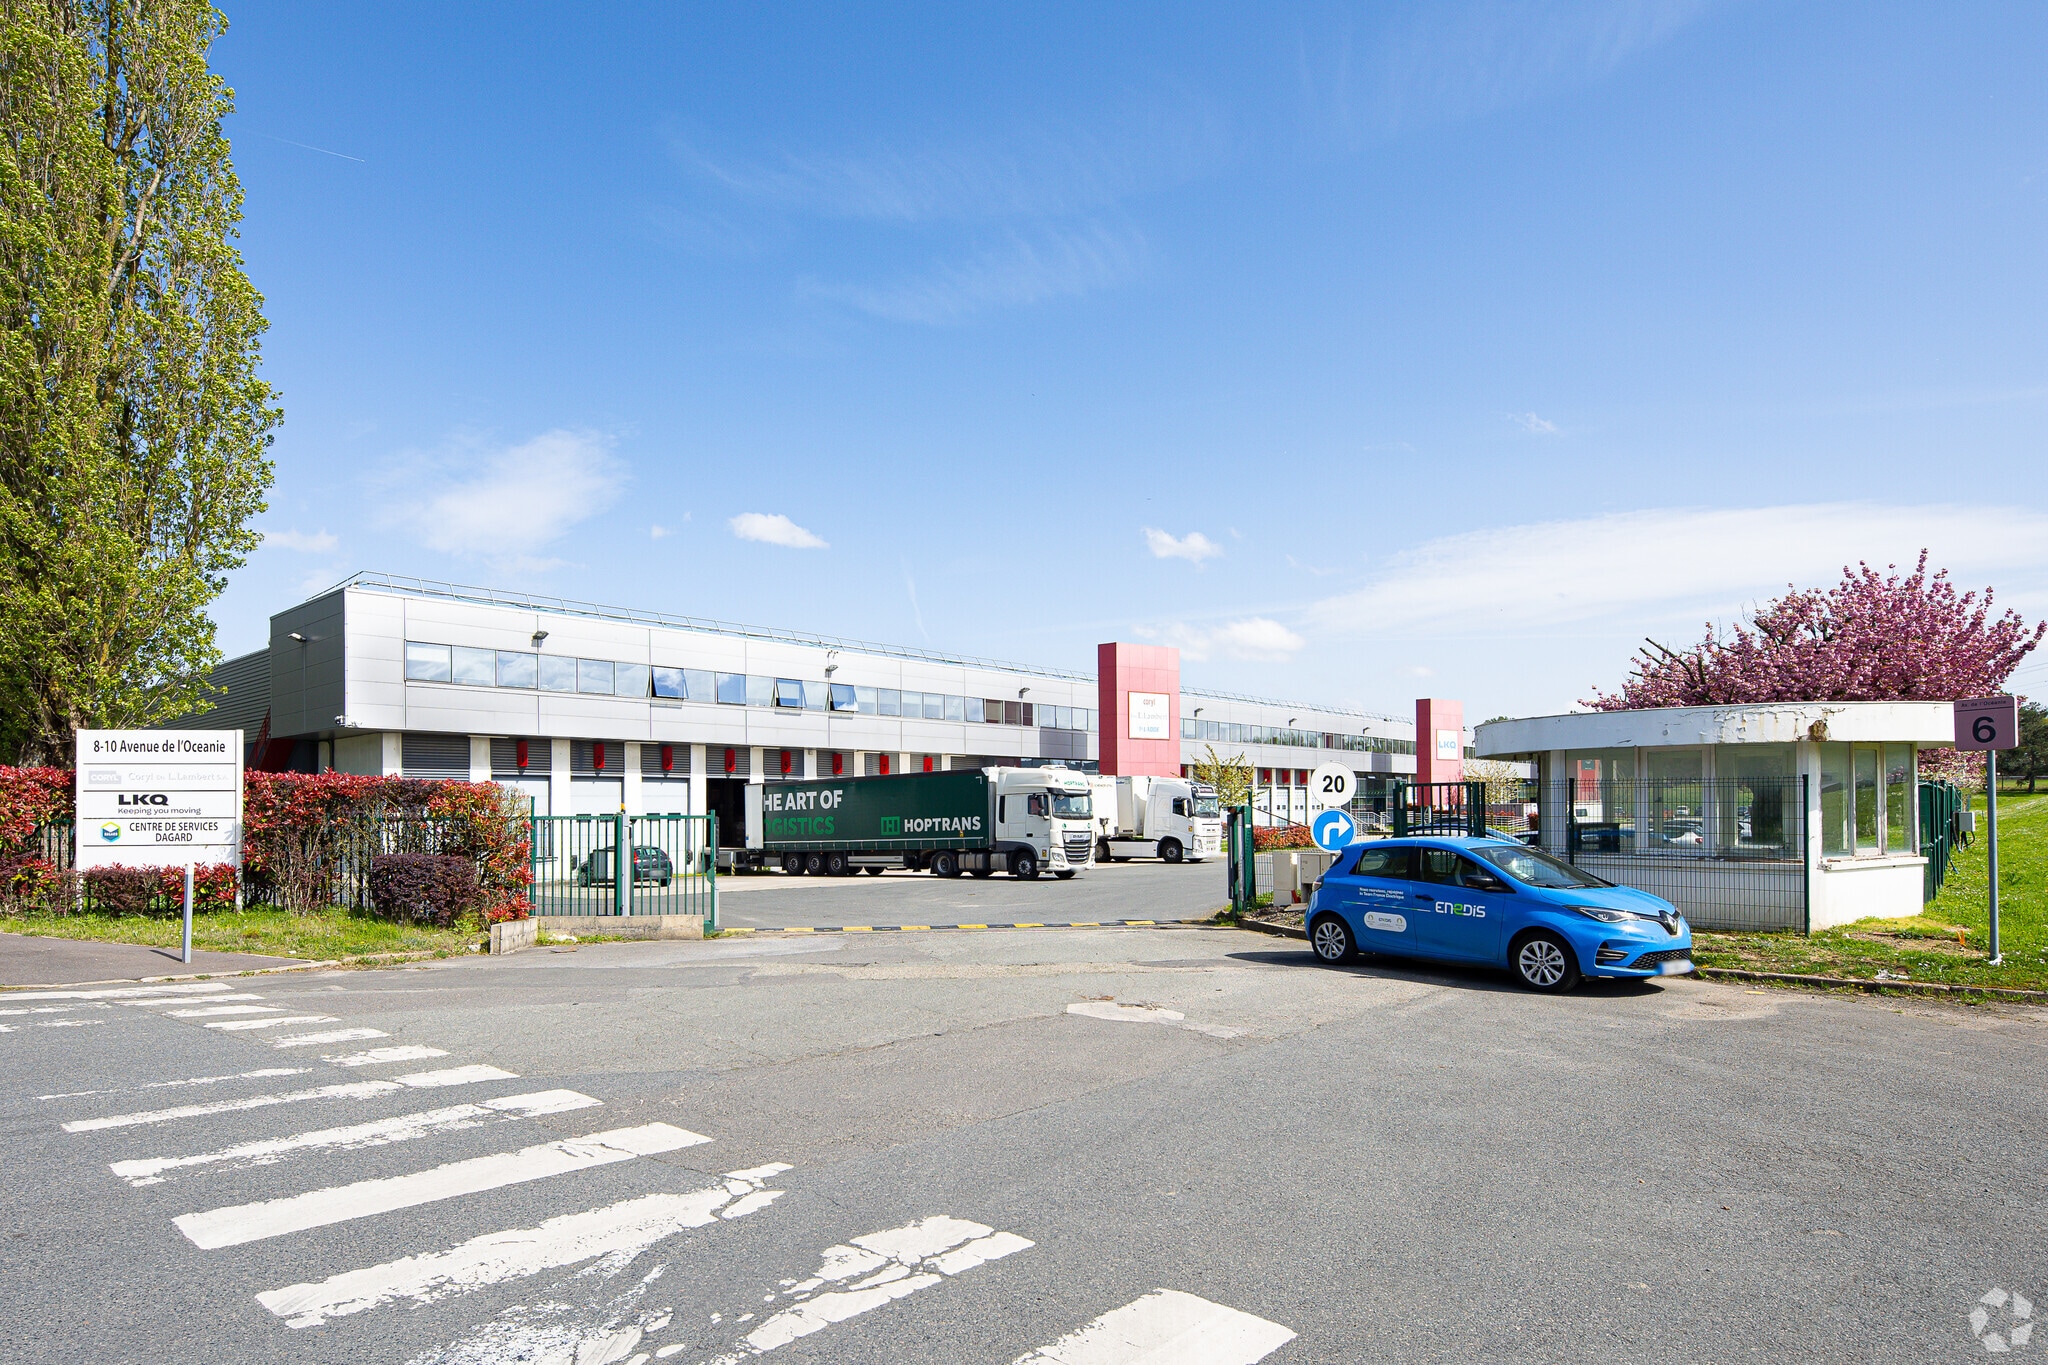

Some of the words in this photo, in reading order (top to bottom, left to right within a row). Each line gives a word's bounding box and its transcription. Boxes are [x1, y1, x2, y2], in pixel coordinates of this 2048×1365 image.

[1973, 717, 1996, 743] 6
[93, 740, 117, 753] 8-10
[120, 740, 160, 753] Avenue
[162, 739, 175, 753] de
[177, 739, 226, 753] l'Oceanie
[1438, 740, 1457, 749] LKQ
[128, 772, 154, 783] Coryl
[1322, 775, 1345, 793] 20
[118, 794, 169, 806] LKQ
[763, 793, 783, 812] HE
[785, 791, 817, 811] ART
[819, 789, 843, 810] OF
[118, 807, 152, 815] Keeping
[171, 807, 202, 815] moving
[129, 822, 163, 832] CENTRE
[165, 822, 176, 832] DE
[179, 821, 219, 831] SERVICES
[904, 815, 982, 833] HOPTRANS
[155, 833, 193, 842] DAGARD
